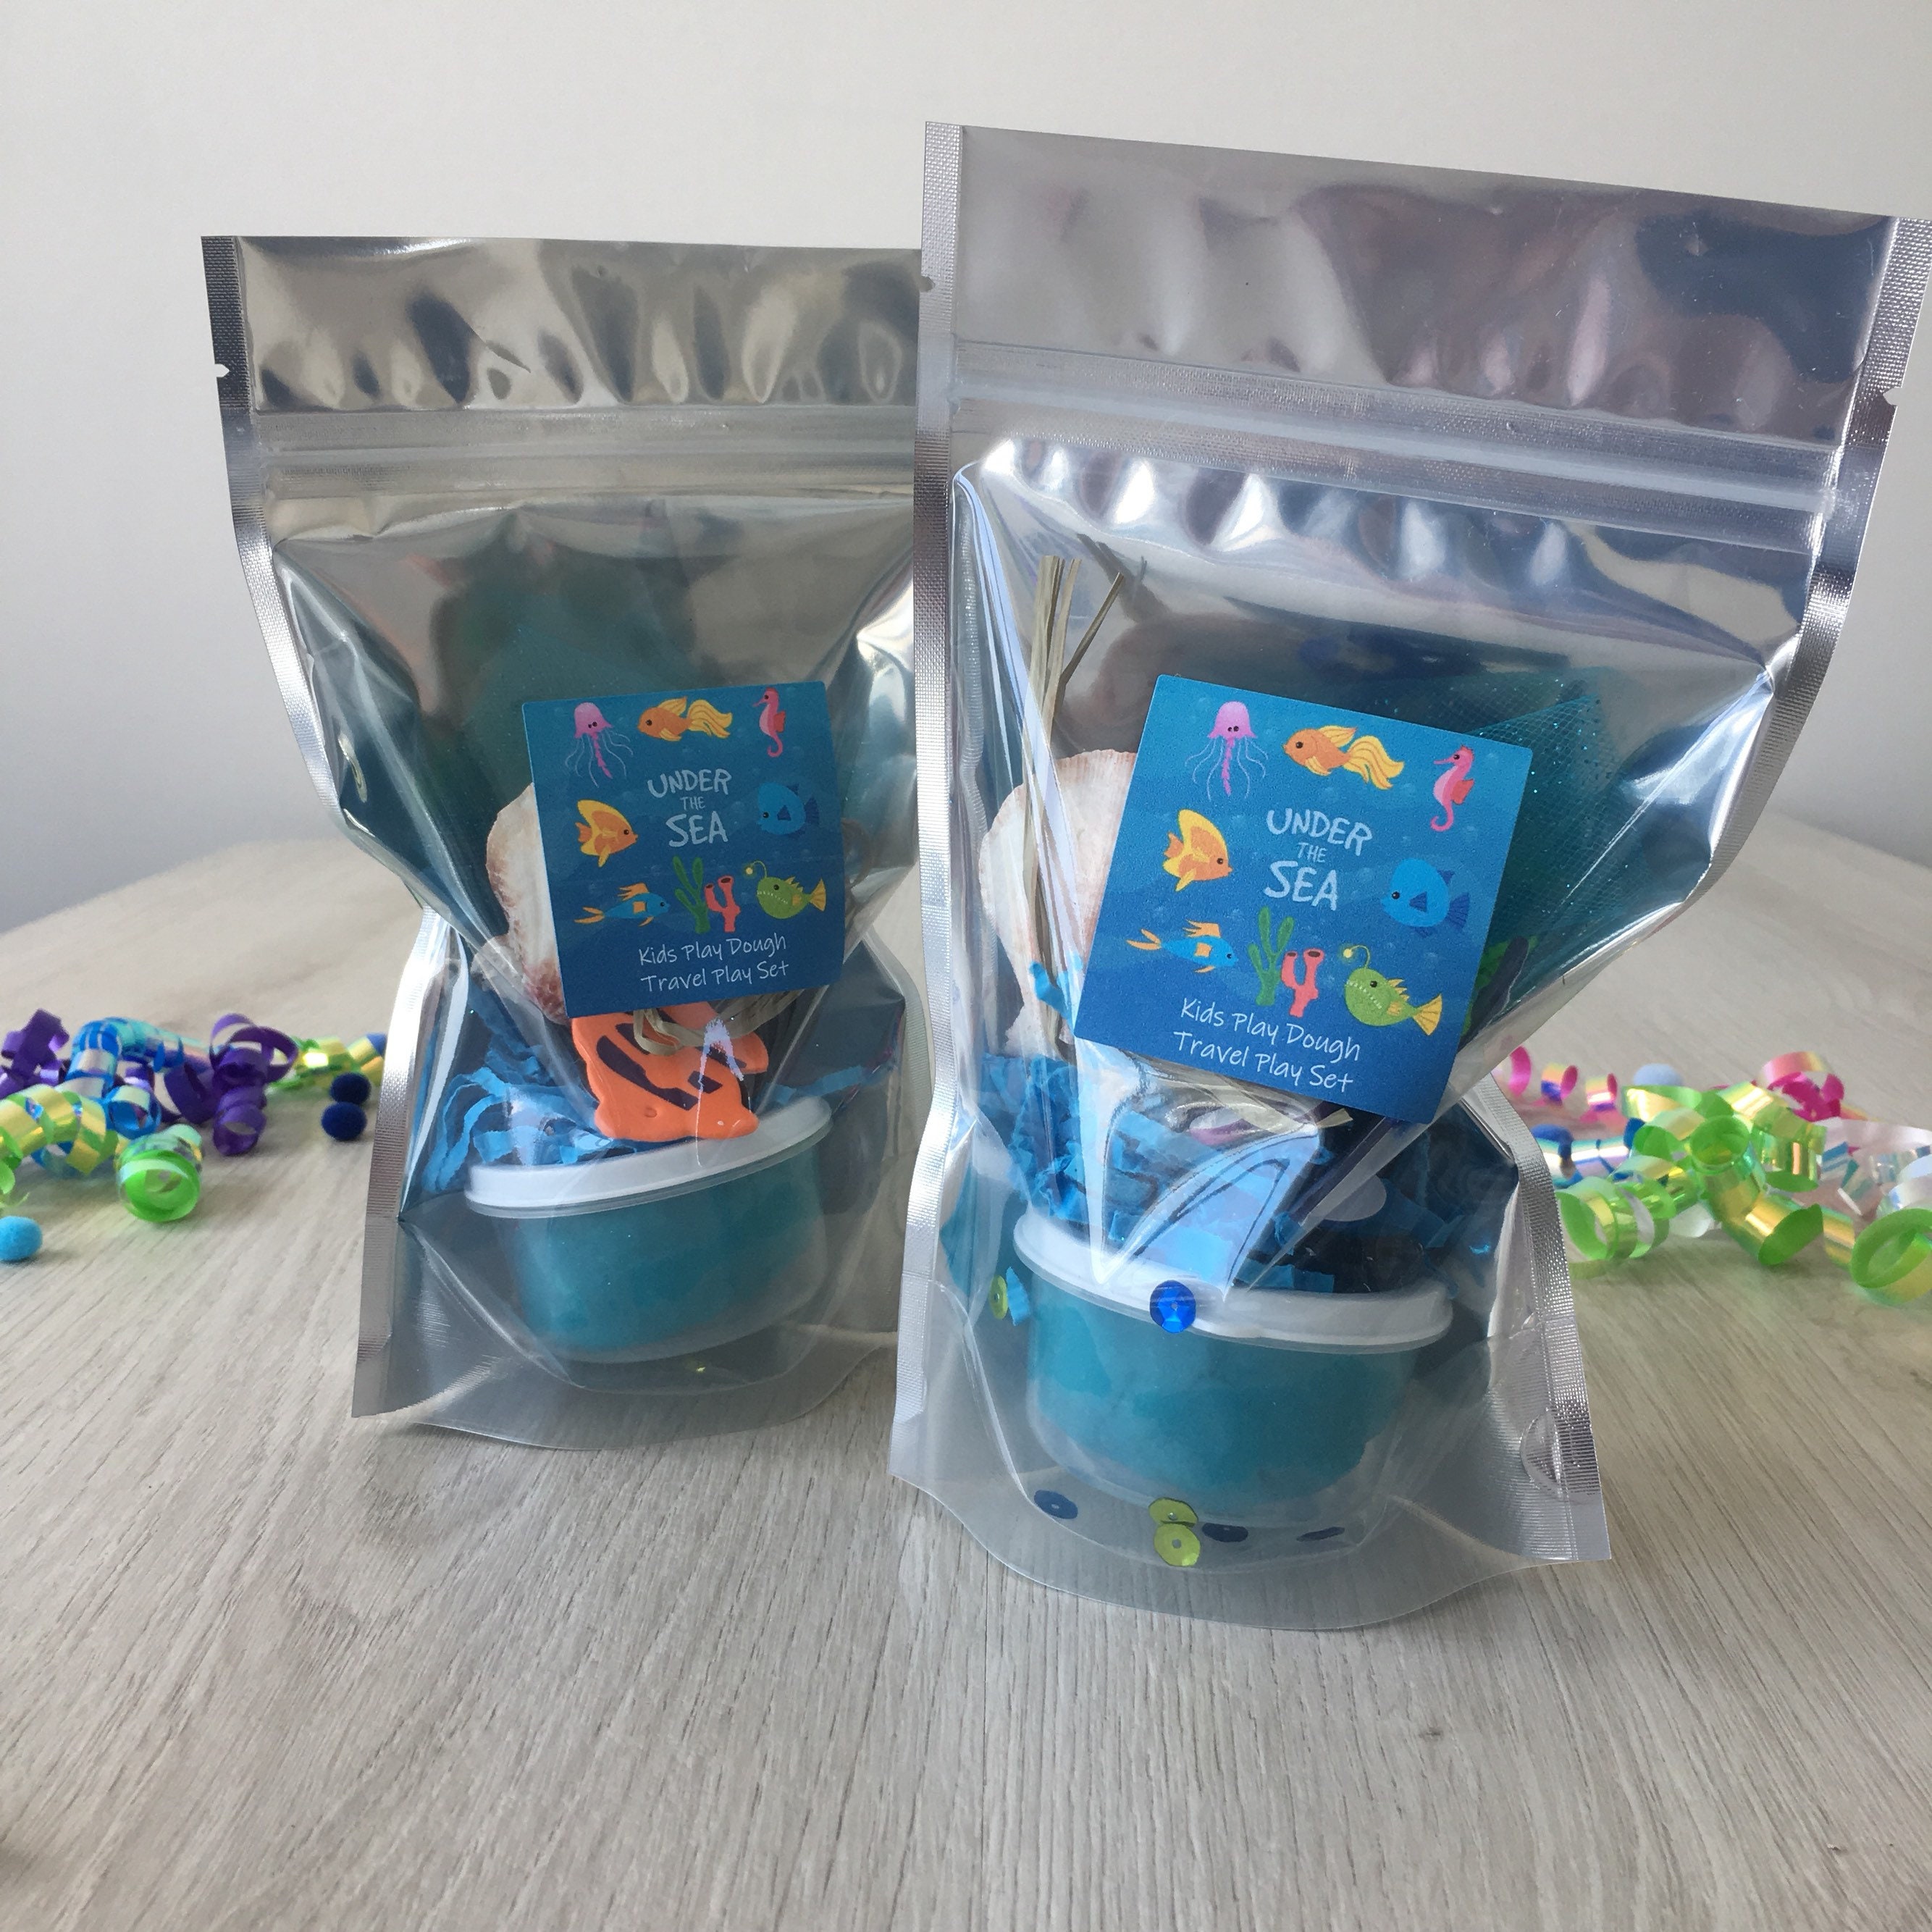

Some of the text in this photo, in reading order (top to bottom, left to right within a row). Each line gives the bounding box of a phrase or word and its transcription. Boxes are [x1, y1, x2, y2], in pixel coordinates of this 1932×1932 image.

[647, 768, 731, 798] UNDER
[680, 797, 705, 810] THE
[665, 810, 728, 847] SEA
[1267, 807, 1372, 856] UNDER
[1297, 841, 1327, 863] THE
[1263, 860, 1339, 911] SEA
[639, 933, 787, 965] Kids Play Dough
[640, 960, 789, 992] Travel Play Set
[1180, 998, 1361, 1063] Kids Play Dough
[1173, 1030, 1354, 1093] Travel Play Set
